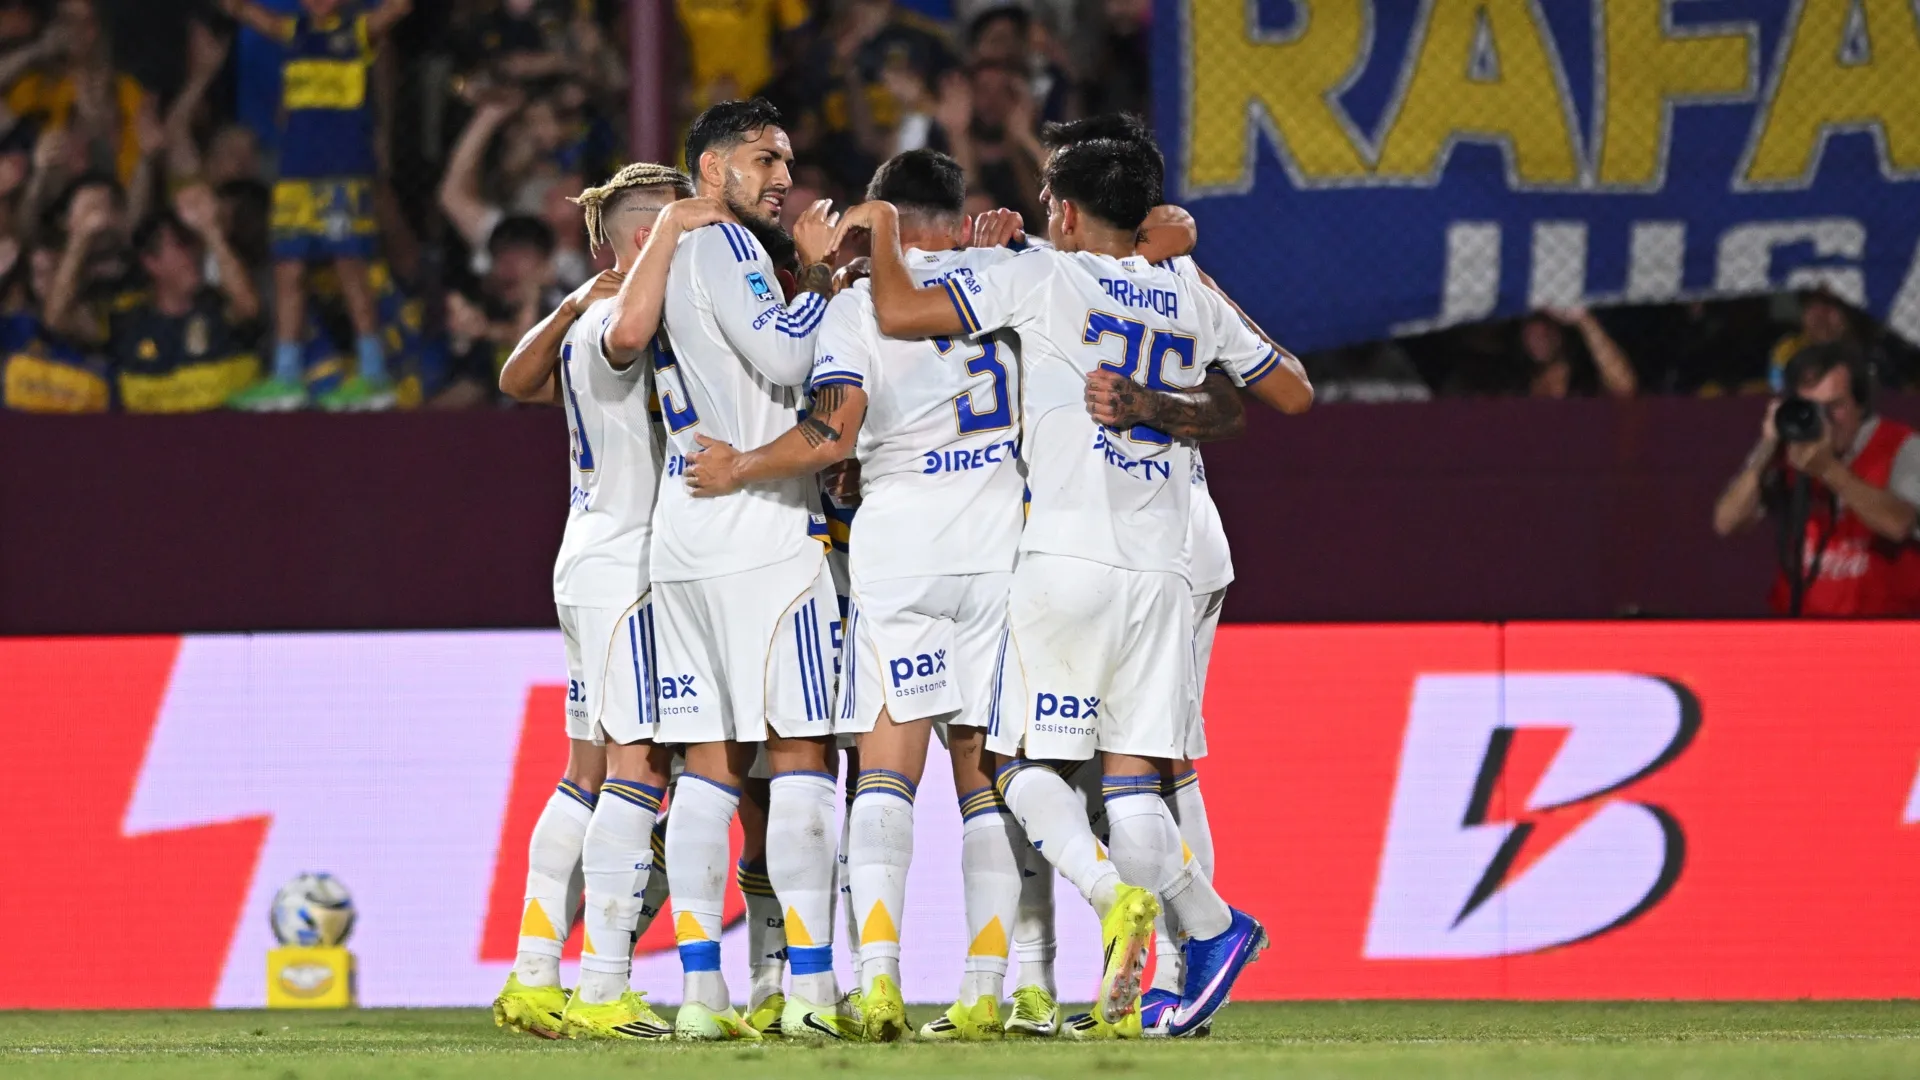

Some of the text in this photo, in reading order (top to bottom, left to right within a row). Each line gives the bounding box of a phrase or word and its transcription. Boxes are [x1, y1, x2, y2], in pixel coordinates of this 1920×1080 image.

[890, 649, 946, 688] pax
[657, 674, 698, 699] ax
[895, 679, 947, 697] assistance
[1035, 692, 1101, 721] pax
[1034, 723, 1096, 735] assistance
